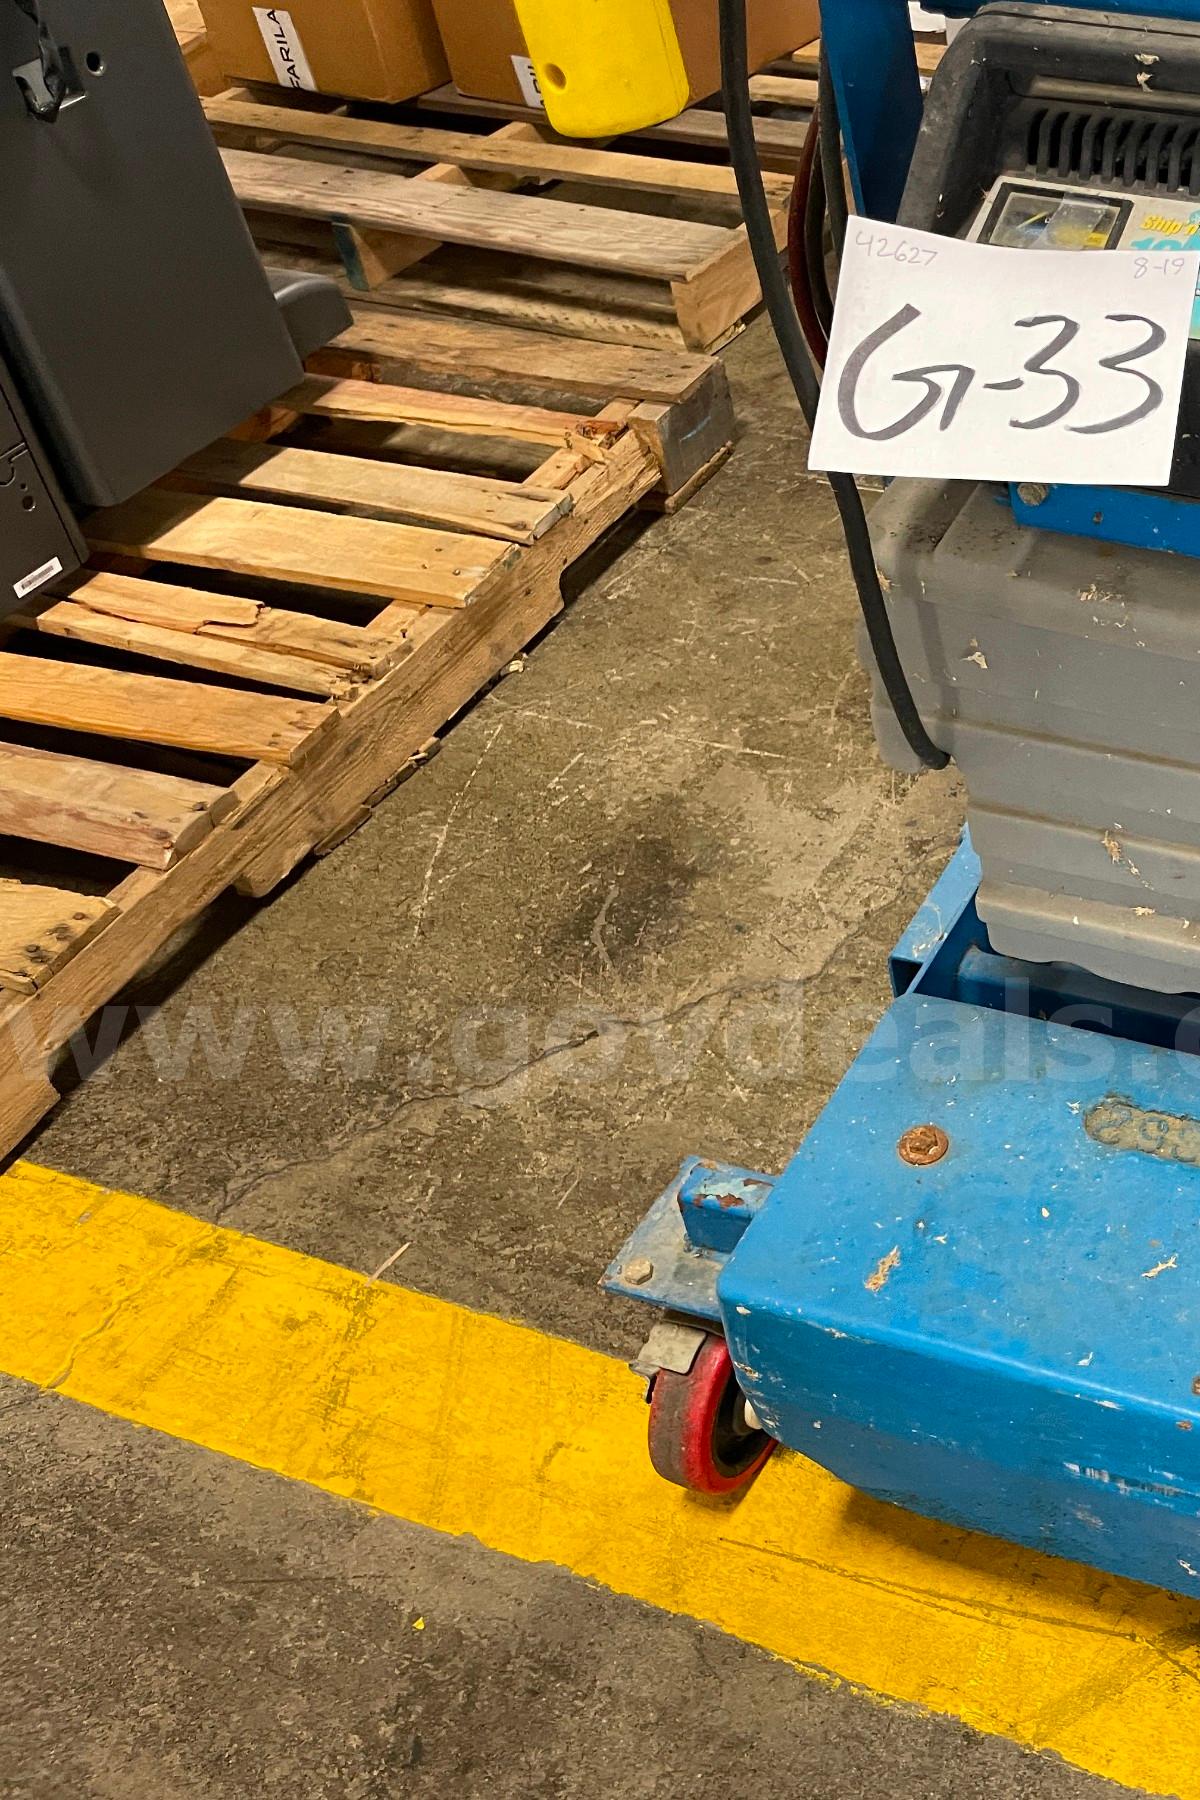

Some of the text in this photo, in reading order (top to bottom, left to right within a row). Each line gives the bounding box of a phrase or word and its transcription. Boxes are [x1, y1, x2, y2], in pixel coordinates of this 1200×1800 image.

[855, 231, 938, 266] 42627
[1134, 256, 1185, 280] 8-19
[837, 303, 1167, 441] G-33
